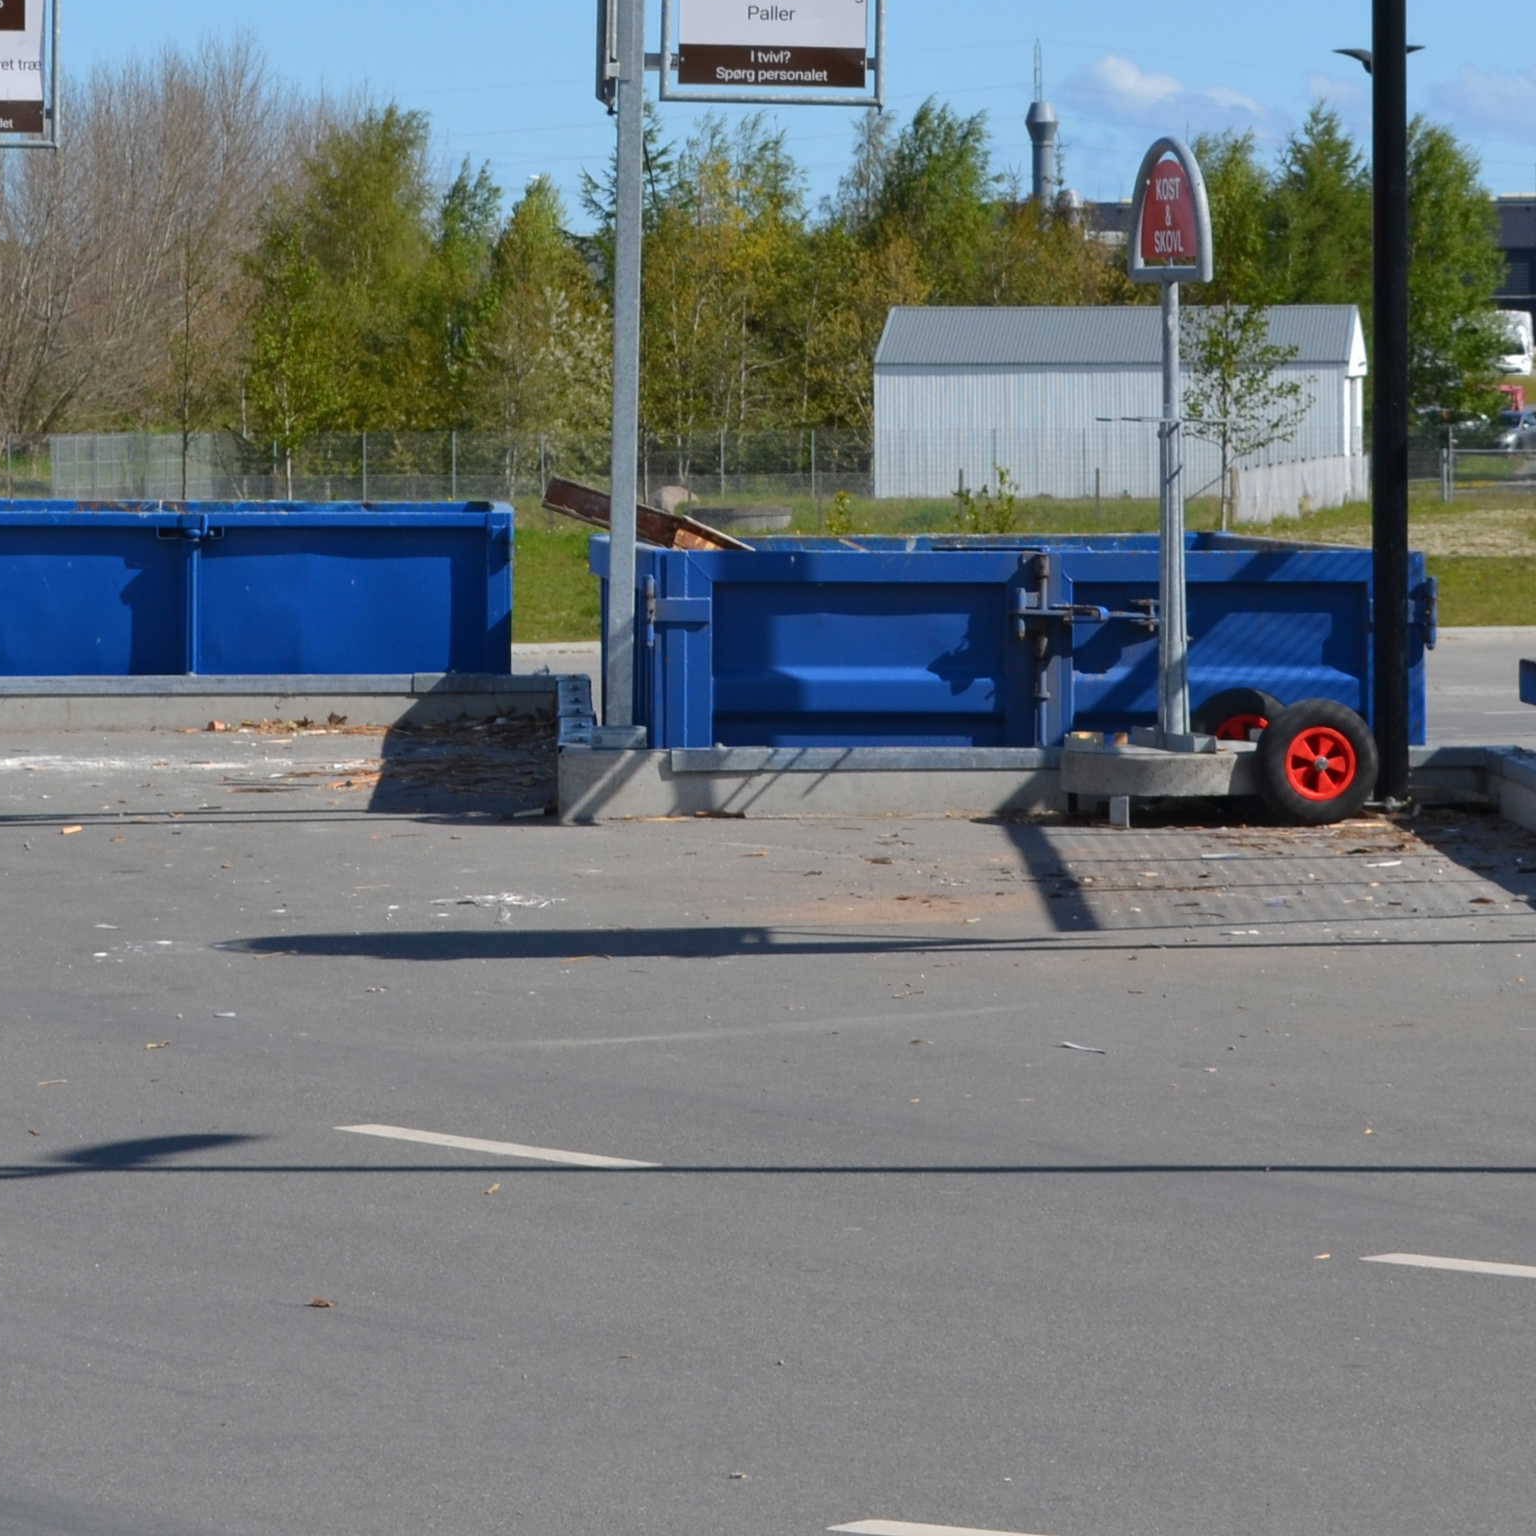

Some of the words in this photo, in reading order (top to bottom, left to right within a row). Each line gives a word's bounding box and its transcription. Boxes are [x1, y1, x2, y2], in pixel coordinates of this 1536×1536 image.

[747, 6, 794, 21] Paller
[18, 59, 42, 71] træ
[759, 51, 791, 64] tvivl?
[716, 67, 755, 82] Spørg
[758, 67, 828, 82] personalet
[1156, 177, 1180, 200] KOST
[1165, 205, 1171, 226] &
[1154, 230, 1183, 253] SKOVL
